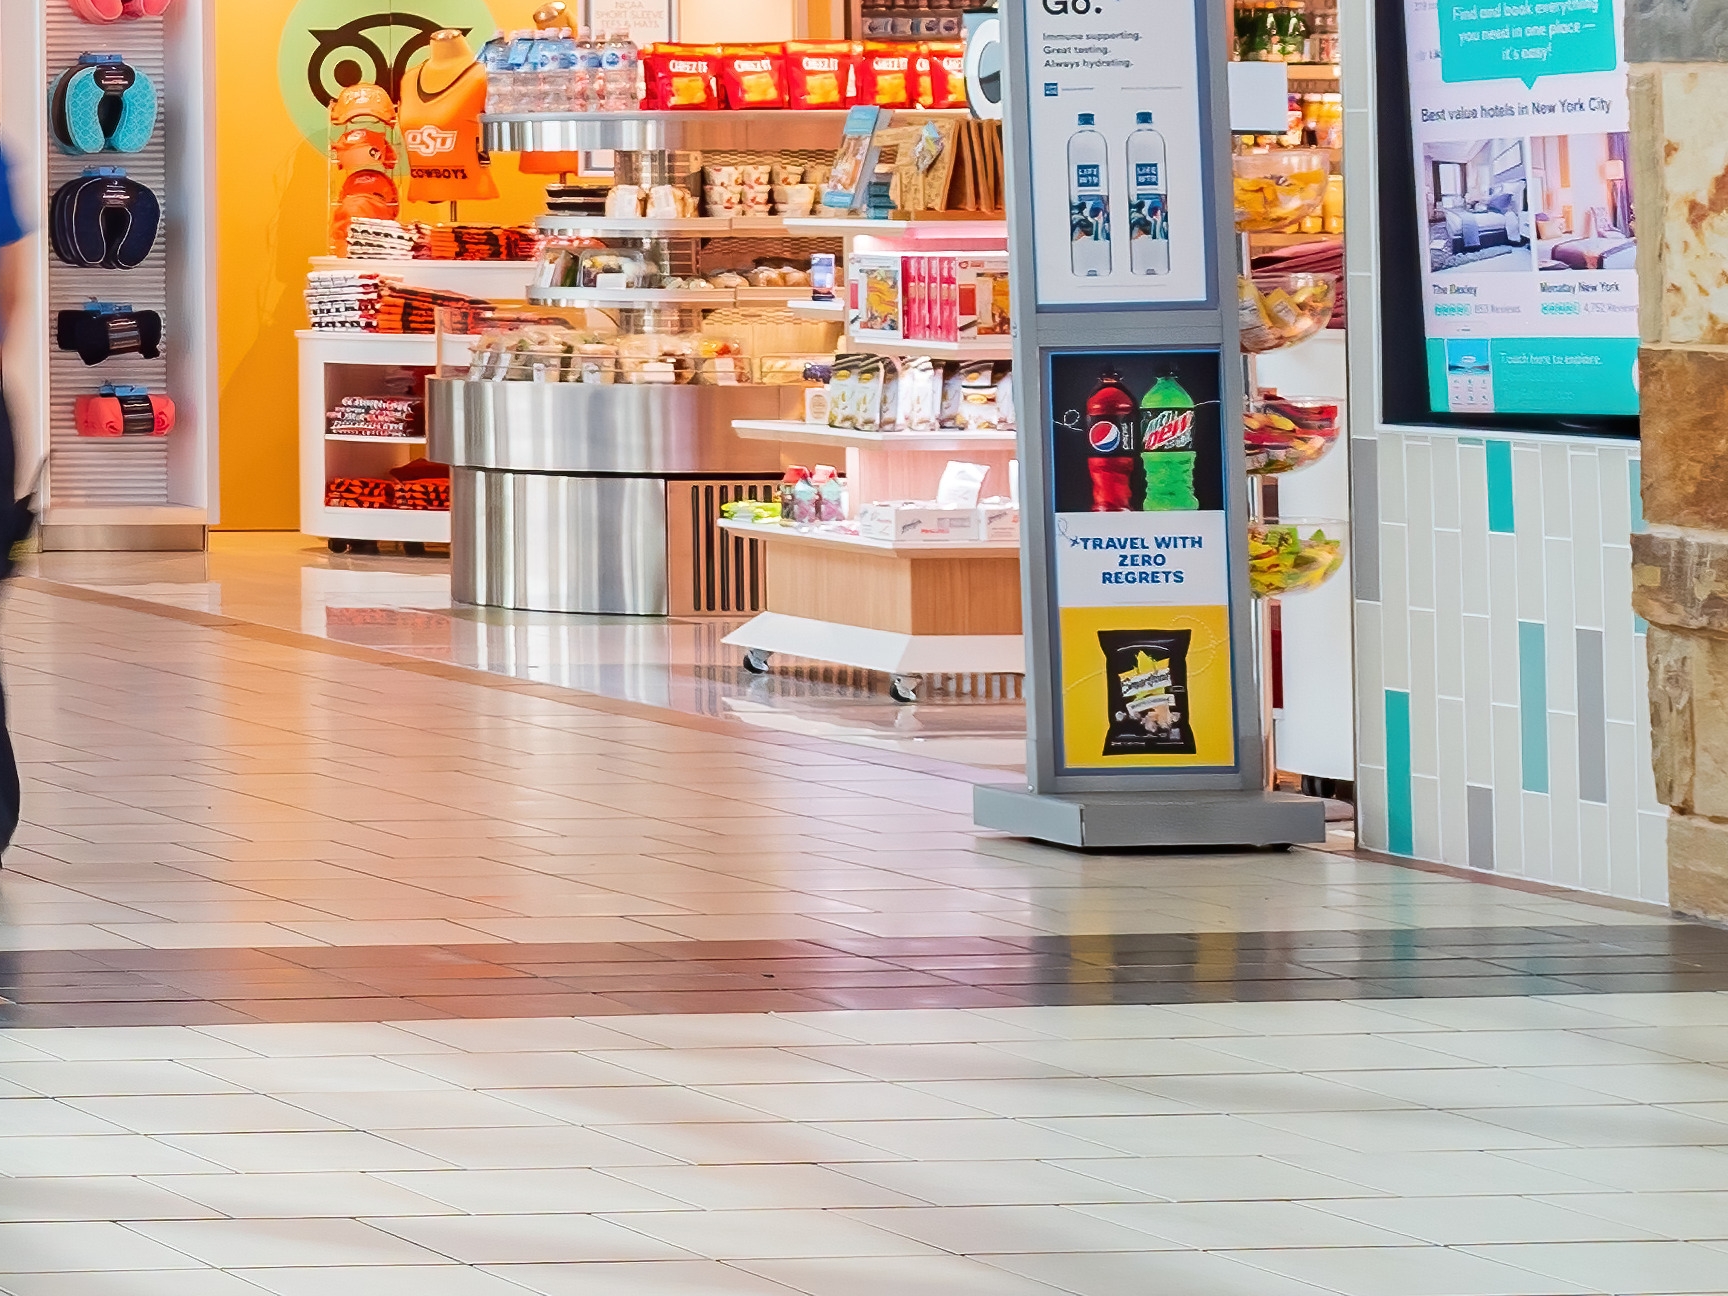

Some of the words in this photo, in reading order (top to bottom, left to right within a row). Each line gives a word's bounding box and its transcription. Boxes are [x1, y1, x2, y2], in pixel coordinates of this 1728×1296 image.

[1043, 45, 1072, 55] Great
[1044, 59, 1080, 69] Always
[1422, 107, 1447, 122] Best
[1518, 103, 1529, 116] in
[1532, 101, 1556, 115] New
[1559, 98, 1584, 113] York
[1589, 97, 1612, 114] City
[407, 128, 453, 154] OSU
[410, 168, 467, 179] COWBOYS
[1079, 537, 1149, 550] TRAVEL
[1154, 536, 1203, 549] WITH
[1118, 554, 1166, 566] ZERO
[1102, 570, 1185, 584] REGRETS
